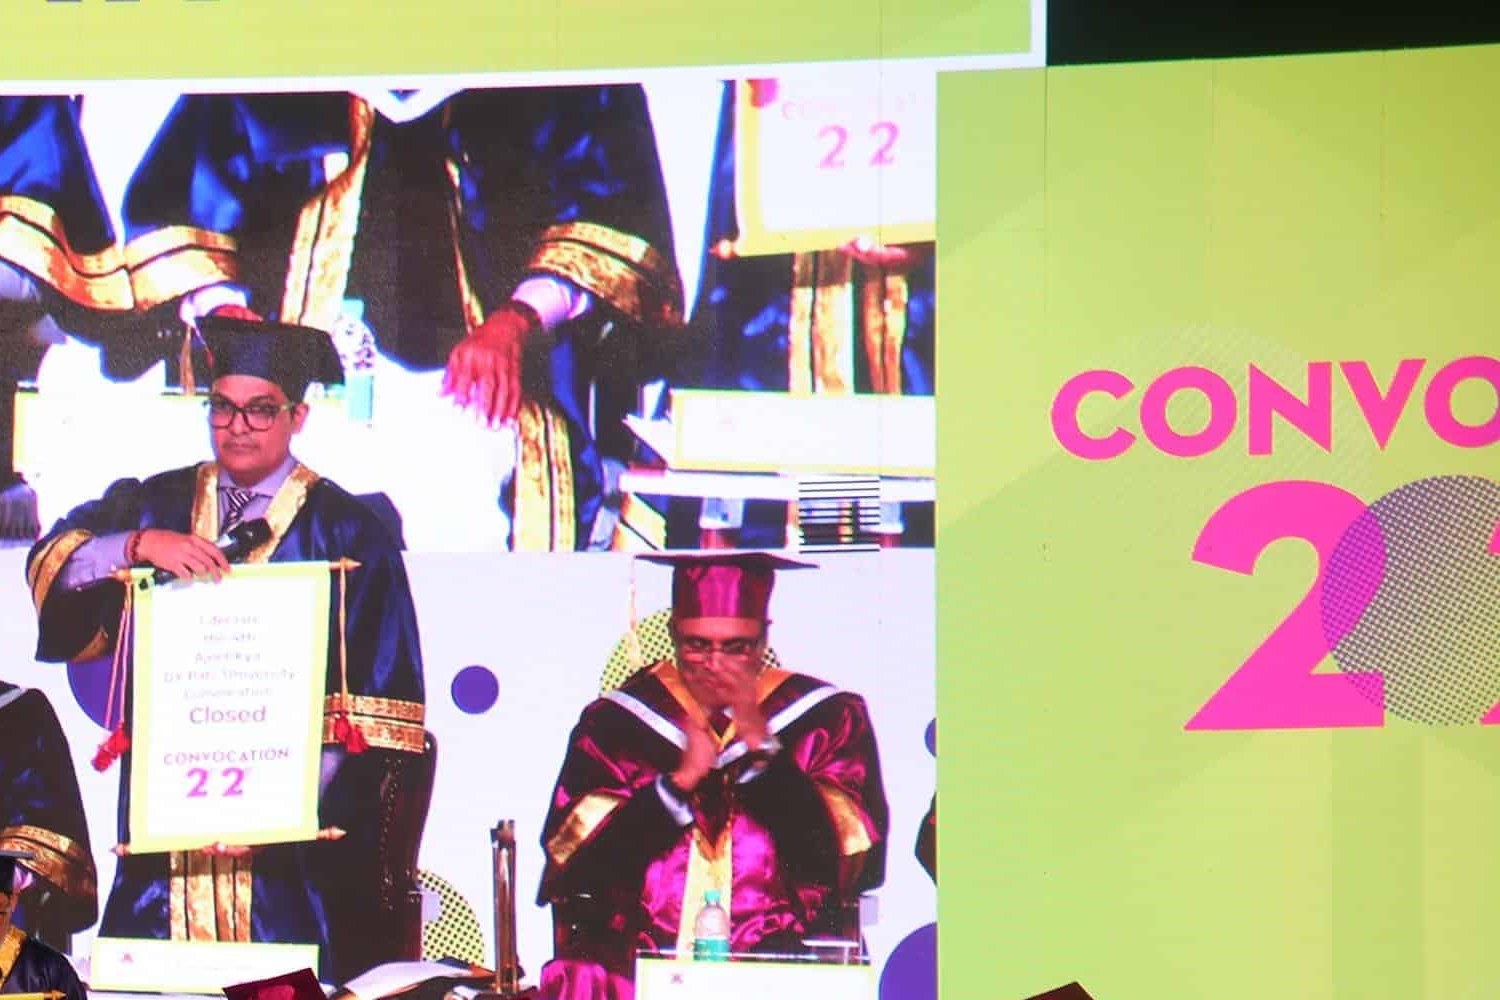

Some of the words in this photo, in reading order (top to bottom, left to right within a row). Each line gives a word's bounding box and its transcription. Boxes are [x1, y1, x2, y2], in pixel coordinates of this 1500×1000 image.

[1051, 356, 1500, 461] CONVO
[189, 705, 267, 725] Closed
[163, 746, 290, 766] CONVOCATION
